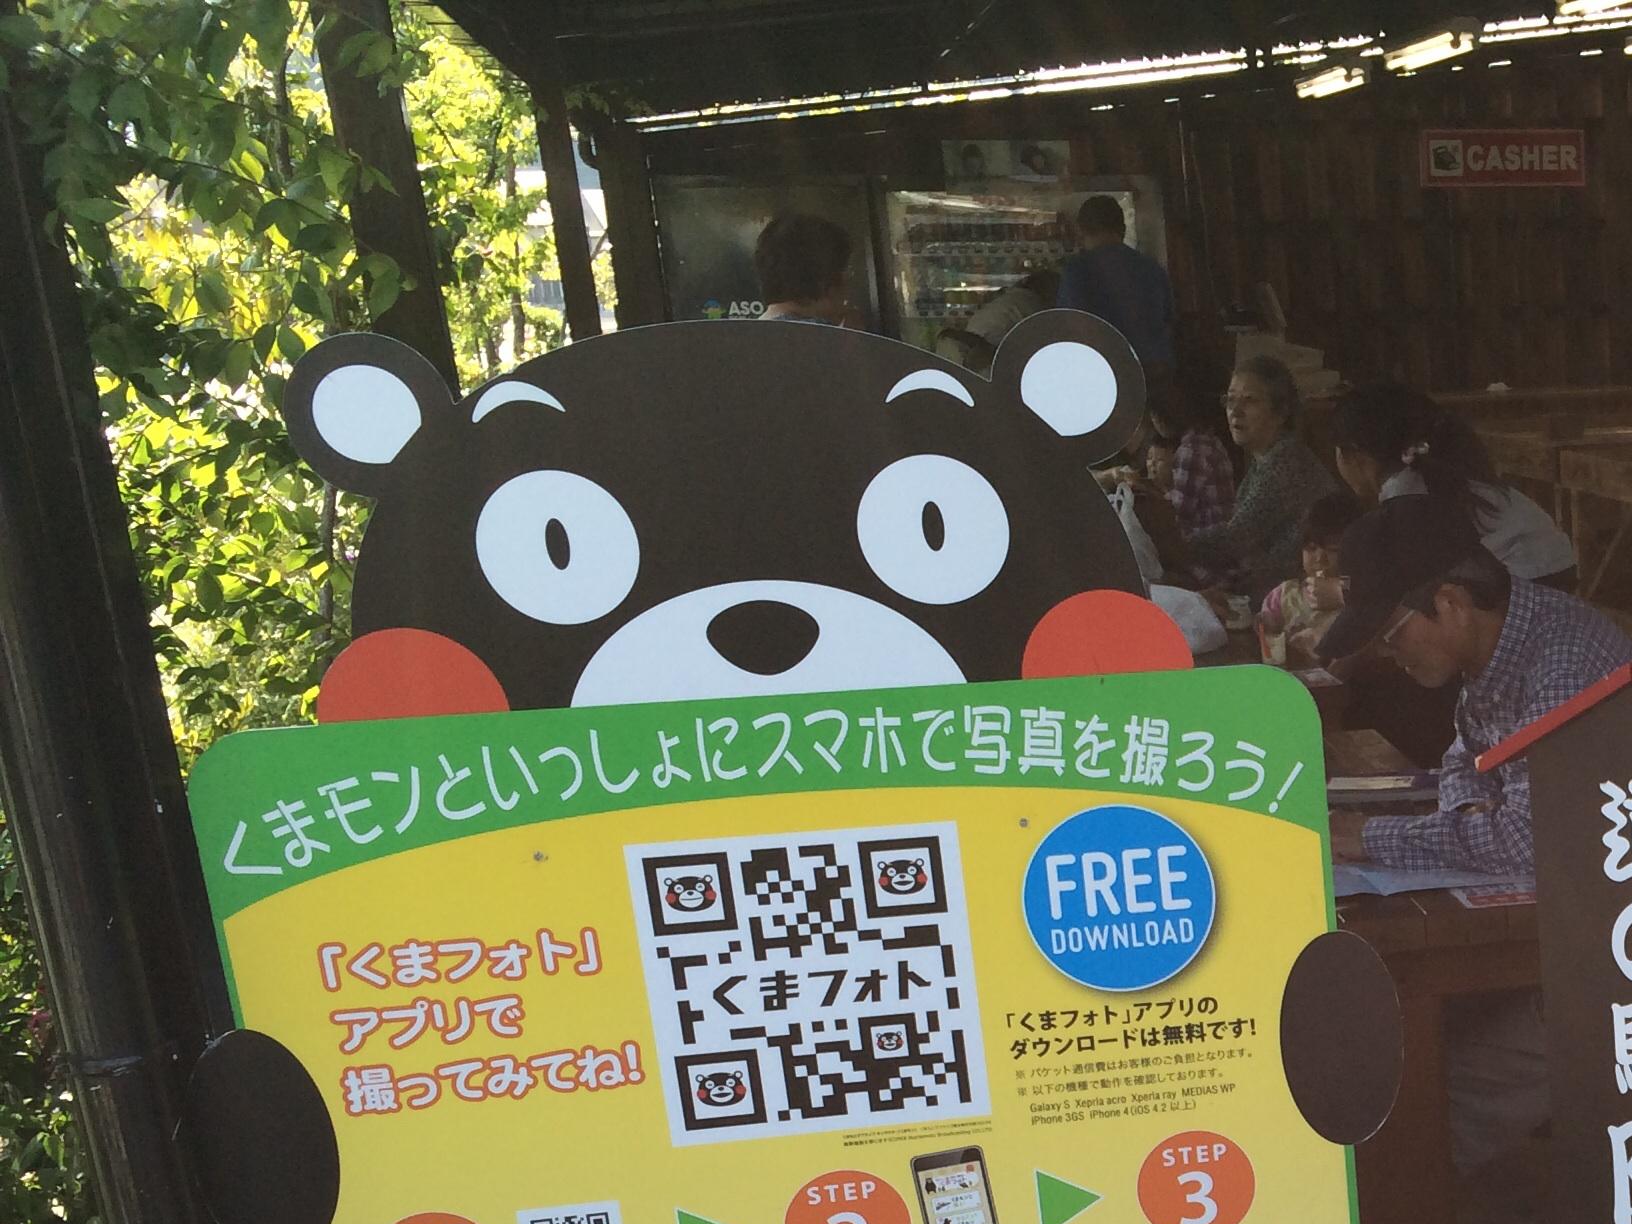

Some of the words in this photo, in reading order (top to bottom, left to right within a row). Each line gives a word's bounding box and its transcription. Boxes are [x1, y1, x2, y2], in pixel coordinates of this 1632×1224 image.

[1467, 144, 1578, 172] CASHER
[728, 300, 764, 315] ASO
[1044, 844, 1194, 921] FREE
[1050, 917, 1195, 957] DOWNLOAD
[318, 928, 602, 991] 「くまフォト」
[712, 960, 932, 1015] くまフォト
[331, 994, 524, 1053] アプリで
[1005, 996, 1219, 1034] 「くまフォト」アプリの
[1029, 1102, 1062, 1113] Galaxy
[1106, 1095, 1127, 1106] acro
[1162, 1091, 1177, 1101] ray
[1181, 1084, 1218, 1098] MEDIAS
[1220, 1083, 1237, 1094] WP
[1031, 1114, 1063, 1126] iPhone
[1065, 1111, 1085, 1122] 3GS
[1089, 1108, 1121, 1120] iPhone
[1162, 1142, 1228, 1168] STEP
[806, 1179, 877, 1206] STEP
